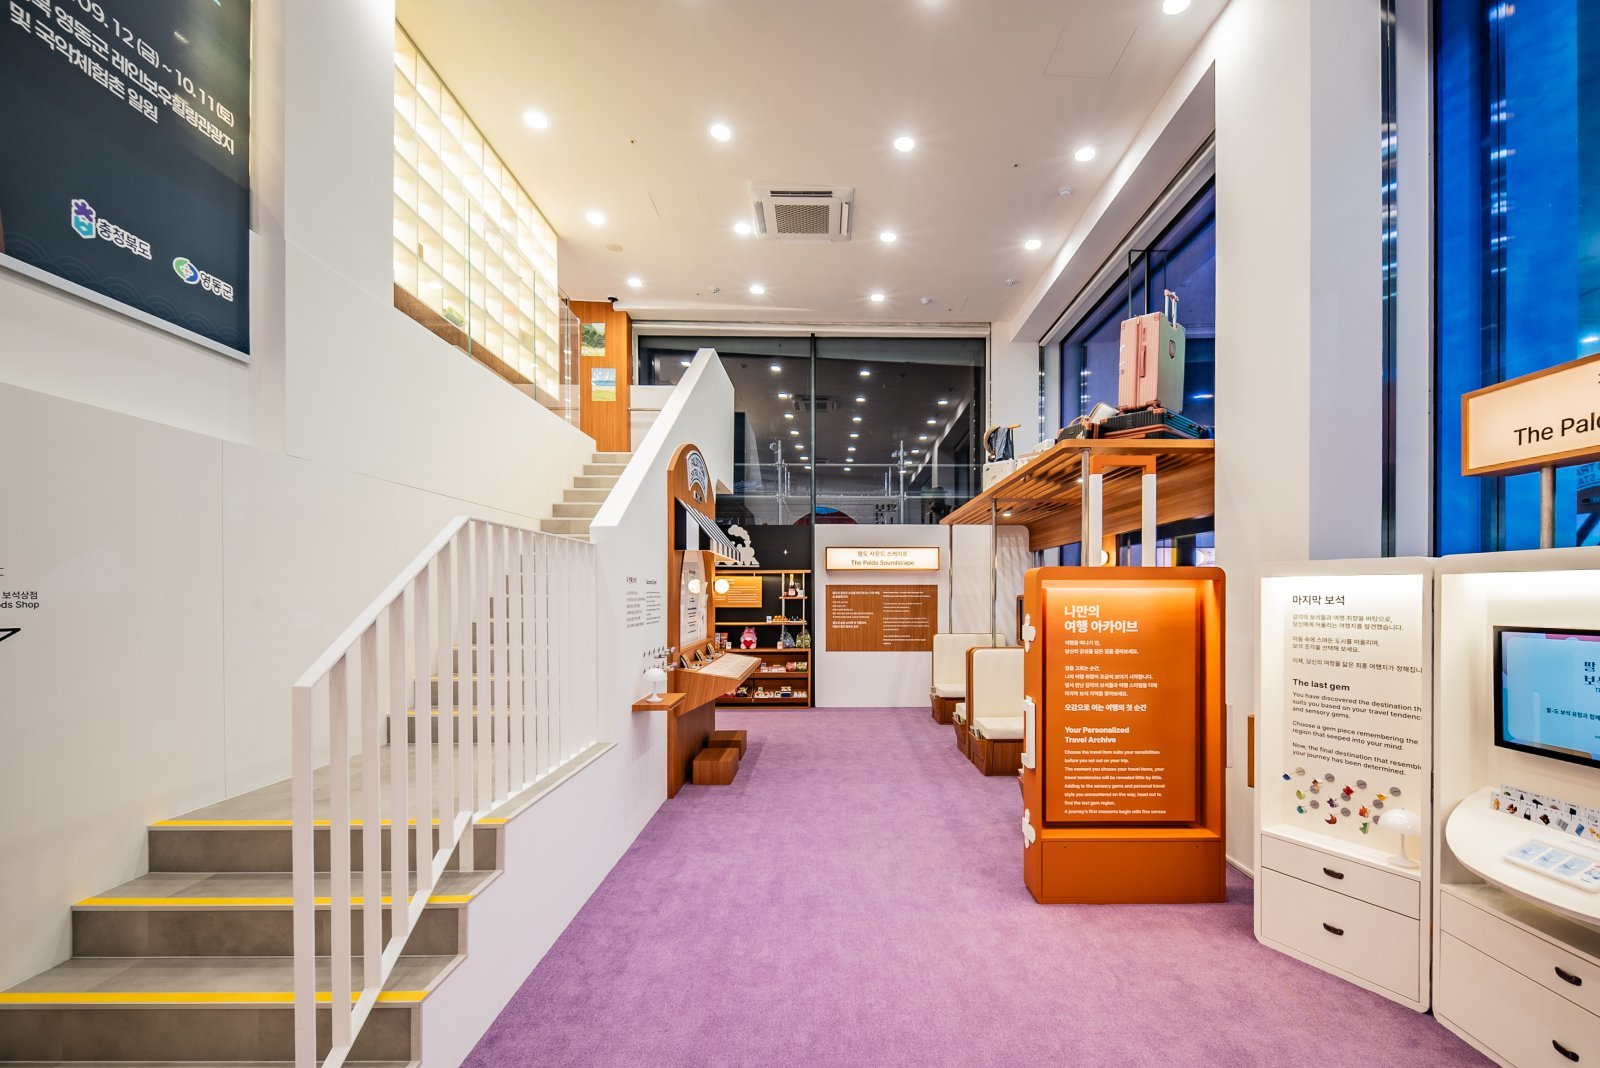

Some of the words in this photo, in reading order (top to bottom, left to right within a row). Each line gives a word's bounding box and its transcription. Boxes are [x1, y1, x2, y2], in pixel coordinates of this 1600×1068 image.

[10, 1, 31, 33] 및
[34, 19, 125, 100] 국악체험촌
[128, 88, 158, 123] 일원
[72, 0, 159, 68] 09.12(금)
[176, 69, 235, 127] 10.11(토)
[55, 6, 109, 61] 영동군
[112, 49, 235, 155] 레인보우힐링관광지
[97, 218, 152, 260] 충청북도
[200, 271, 233, 302] 영동군
[1514, 427, 1553, 446] The
[2, 591, 38, 600] 보석상점
[1292, 595, 1321, 605] 마지막
[1325, 595, 1345, 605] 보석
[15, 601, 39, 609] Shop
[1065, 605, 1099, 618] 나만의
[1065, 620, 1088, 633] 여행
[1091, 620, 1138, 633] 아카이브
[1369, 664, 1394, 672] 여행지가
[1397, 666, 1422, 674] 정해집니
[1293, 679, 1309, 687] The
[1311, 681, 1327, 689] last
[1321, 702, 1340, 710] based
[1369, 708, 1389, 716] travel
[1322, 695, 1357, 704] discovered
[1372, 701, 1412, 711] destination
[1305, 708, 1329, 717] sensory
[1293, 728, 1311, 737] region
[1327, 733, 1350, 744] seeped
[1367, 740, 1382, 748] your
[1384, 742, 1404, 750] mind.
[1337, 727, 1355, 735] piece
[1357, 730, 1404, 743] remembering
[1335, 749, 1372, 760] destination
[1307, 751, 1330, 761] journey
[1363, 762, 1406, 775] determined.
